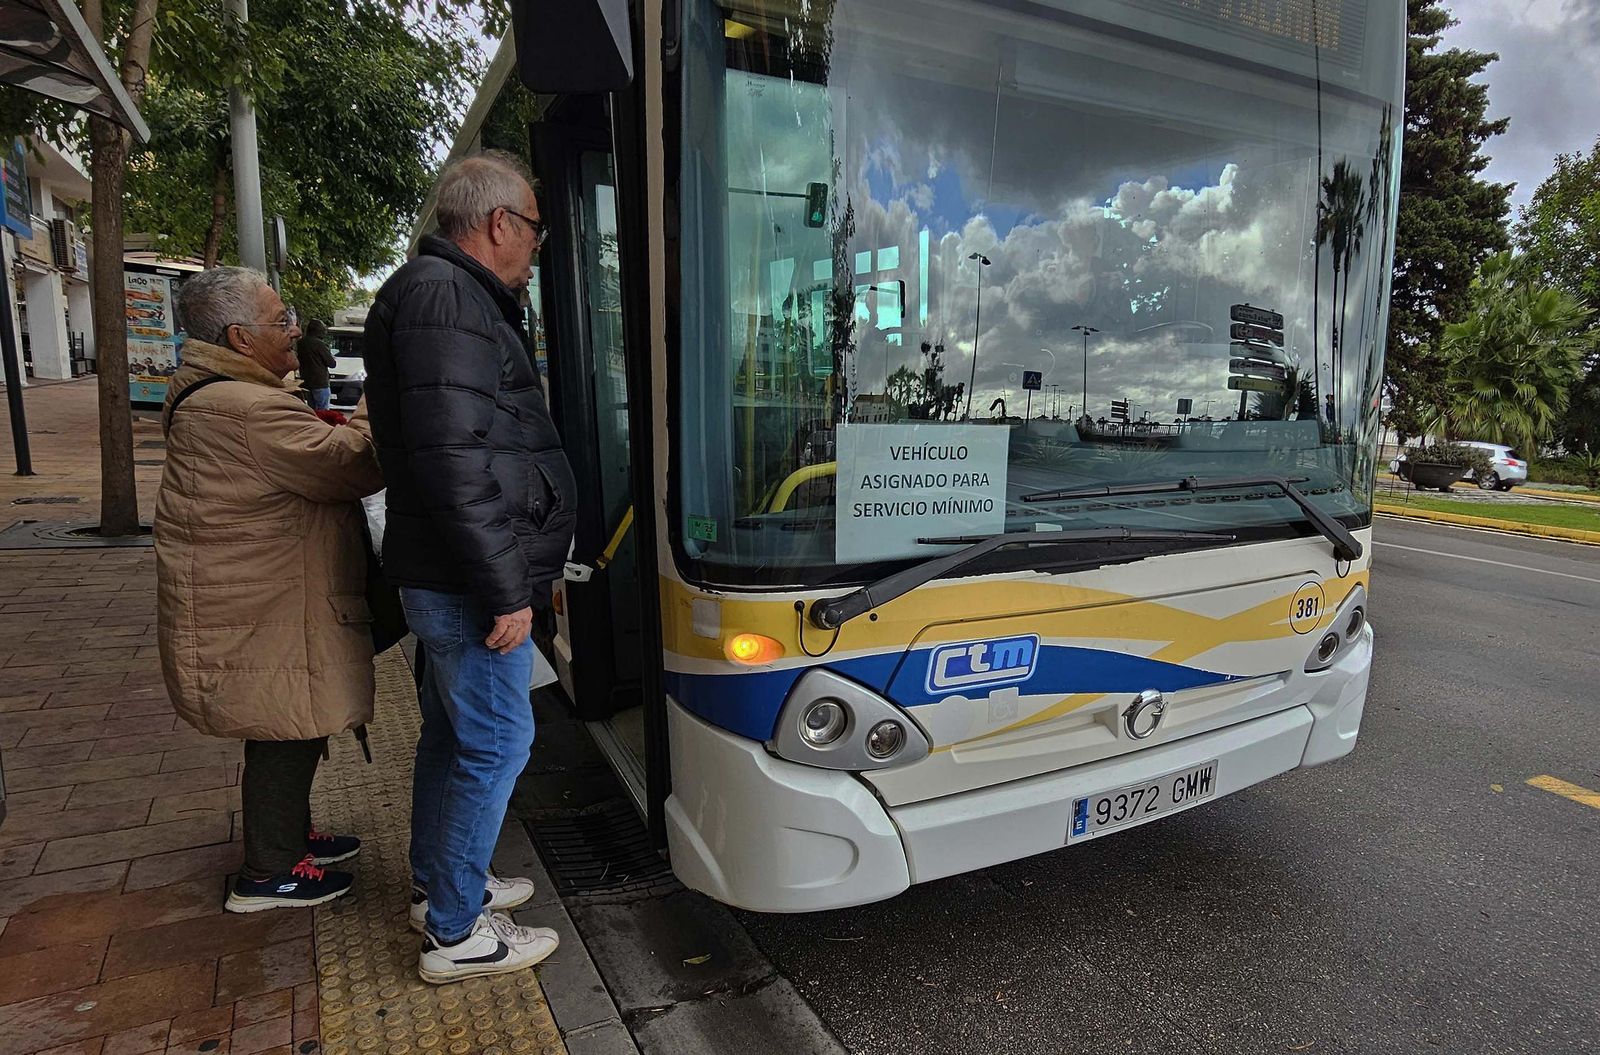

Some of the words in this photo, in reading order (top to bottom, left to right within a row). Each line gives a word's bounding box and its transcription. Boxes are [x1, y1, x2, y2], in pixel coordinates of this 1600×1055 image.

[889, 442, 968, 461] VEHÍCULO
[860, 473, 947, 489] ASIGNADO
[952, 472, 990, 487] PARA
[853, 501, 927, 517] SERVICIO
[932, 497, 994, 515] MÍNIMO
[1296, 596, 1319, 619] 381
[1096, 785, 1160, 826] 9372
[1172, 766, 1213, 804] GMW
